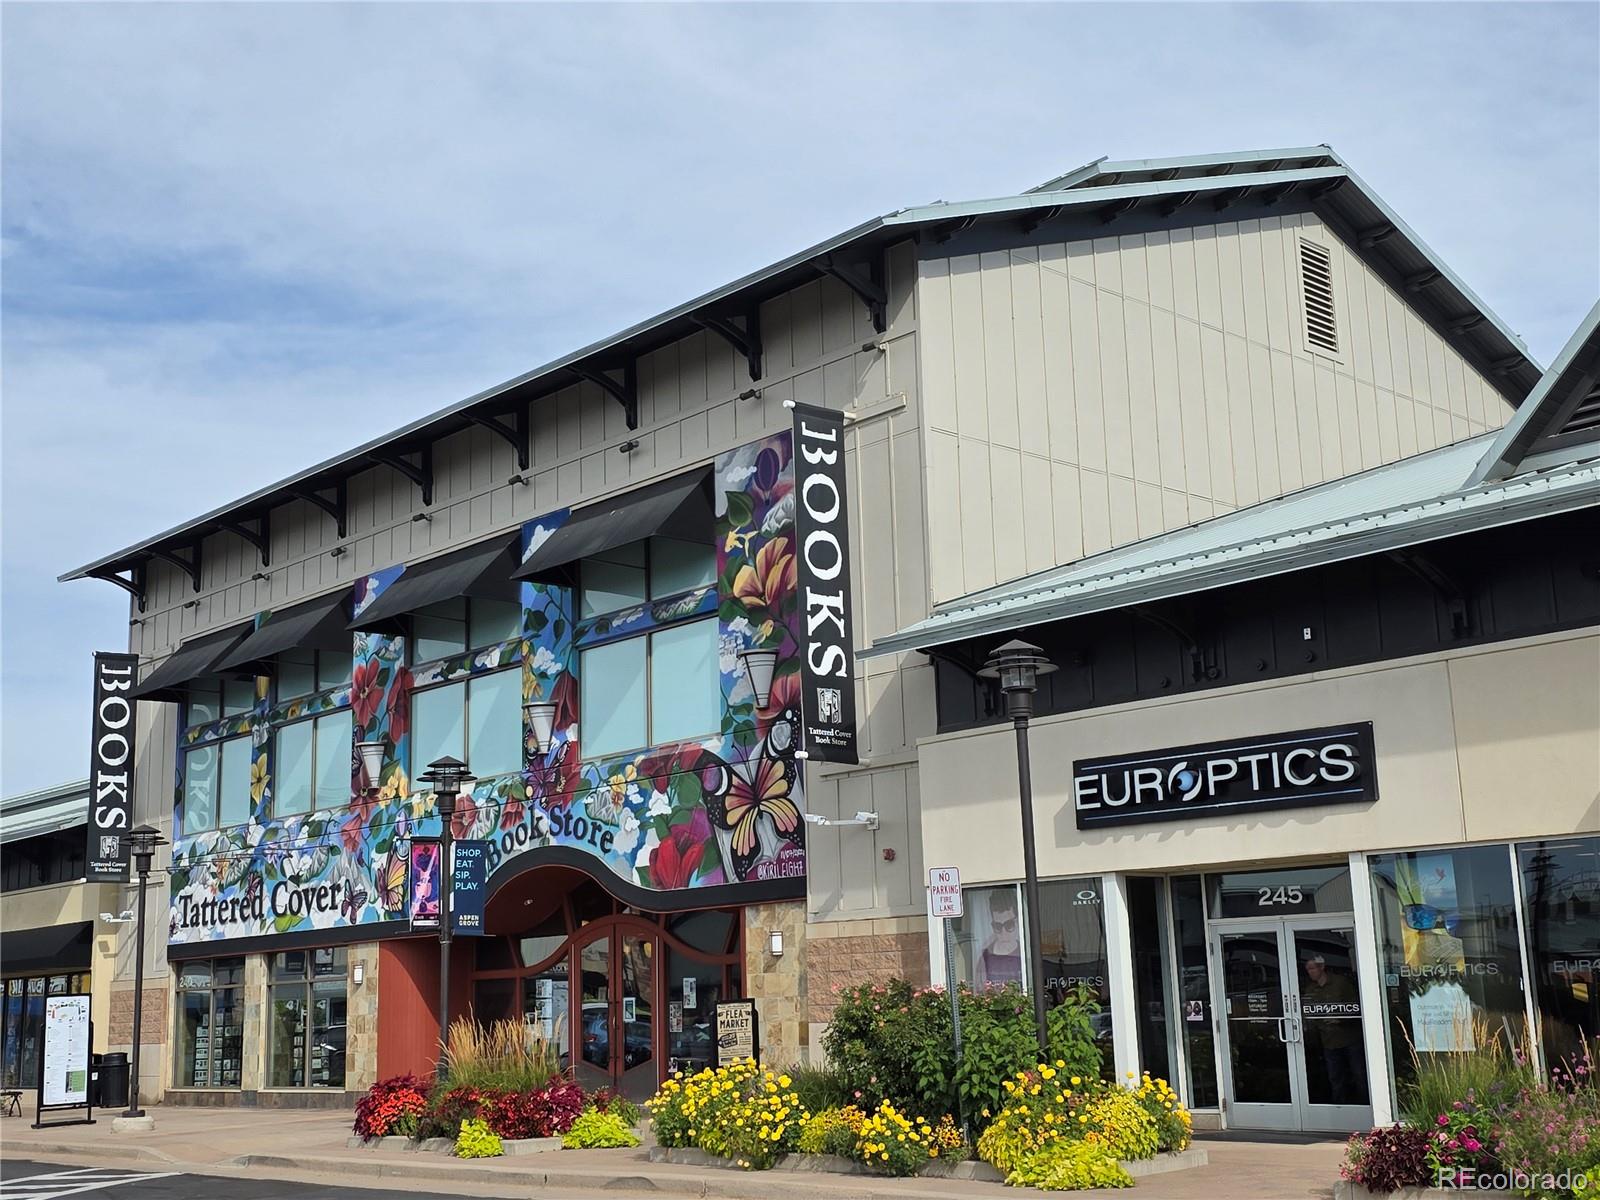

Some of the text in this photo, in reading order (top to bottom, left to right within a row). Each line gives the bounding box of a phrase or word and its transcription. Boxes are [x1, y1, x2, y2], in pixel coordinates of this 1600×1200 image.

[801, 421, 848, 679] BOOKS
[808, 727, 852, 738] Tattered Cover
[815, 736, 847, 746] Book Store
[95, 664, 131, 829] BOOKS
[1074, 743, 1355, 810] EUROPTICS
[486, 804, 614, 873] Book Store
[456, 848, 482, 857] SHOP.
[456, 860, 475, 868] EAT.
[455, 871, 471, 879] SIP.
[938, 873, 950, 882] NO
[455, 882, 479, 890] PLAY.
[932, 885, 958, 895] PARKING
[1258, 886, 1303, 906] 245
[179, 880, 342, 929] Tattered Cover
[1400, 963, 1498, 977] EUROPTICS
[1044, 976, 1103, 989] UROPTICS
[1303, 1004, 1360, 1014] EUROPTICS
[725, 1010, 744, 1019] FLEA
[720, 1019, 749, 1029] MARKET
